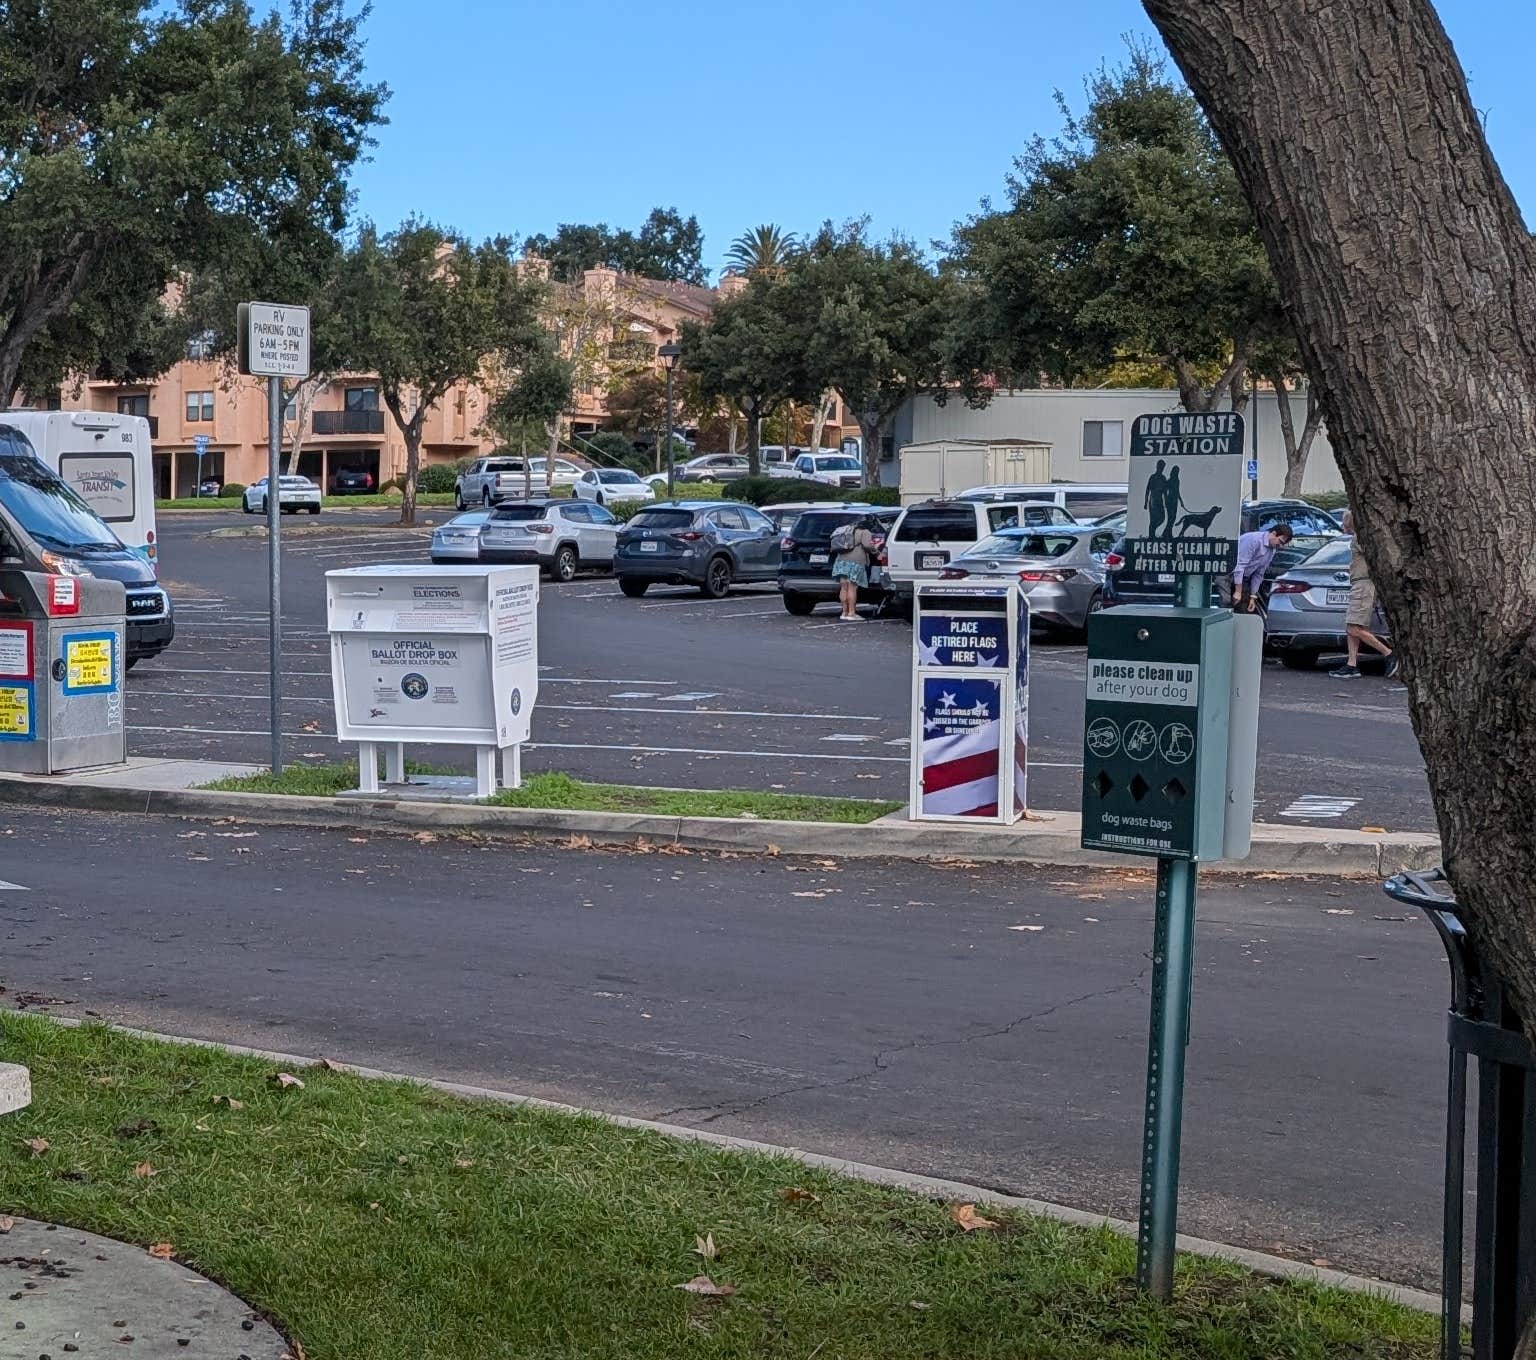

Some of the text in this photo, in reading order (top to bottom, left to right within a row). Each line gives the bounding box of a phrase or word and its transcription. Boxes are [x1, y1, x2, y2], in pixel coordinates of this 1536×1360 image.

[273, 310, 285, 322] RV
[253, 322, 305, 338] PARKING ONLY
[1139, 414, 1237, 435] DOG WASTE
[121, 433, 133, 443] 983
[1143, 438, 1230, 455] STATION
[81, 481, 114, 493] TRANSIT
[1133, 542, 1230, 556] PLEASE CLEAN UP
[1134, 557, 1228, 573] AFTER YOUR DOG
[413, 590, 461, 598] ELECTIONS
[950, 621, 979, 634] PLACE
[393, 640, 435, 650] OFFICIAL
[931, 635, 997, 649] RETIRED FLAGS
[371, 649, 458, 660] BALLOT DROP BOX
[951, 650, 976, 663] HERE
[1092, 662, 1193, 684] please clean up
[1096, 680, 1188, 702] after your dog
[1101, 812, 1173, 831] dog waste bags
